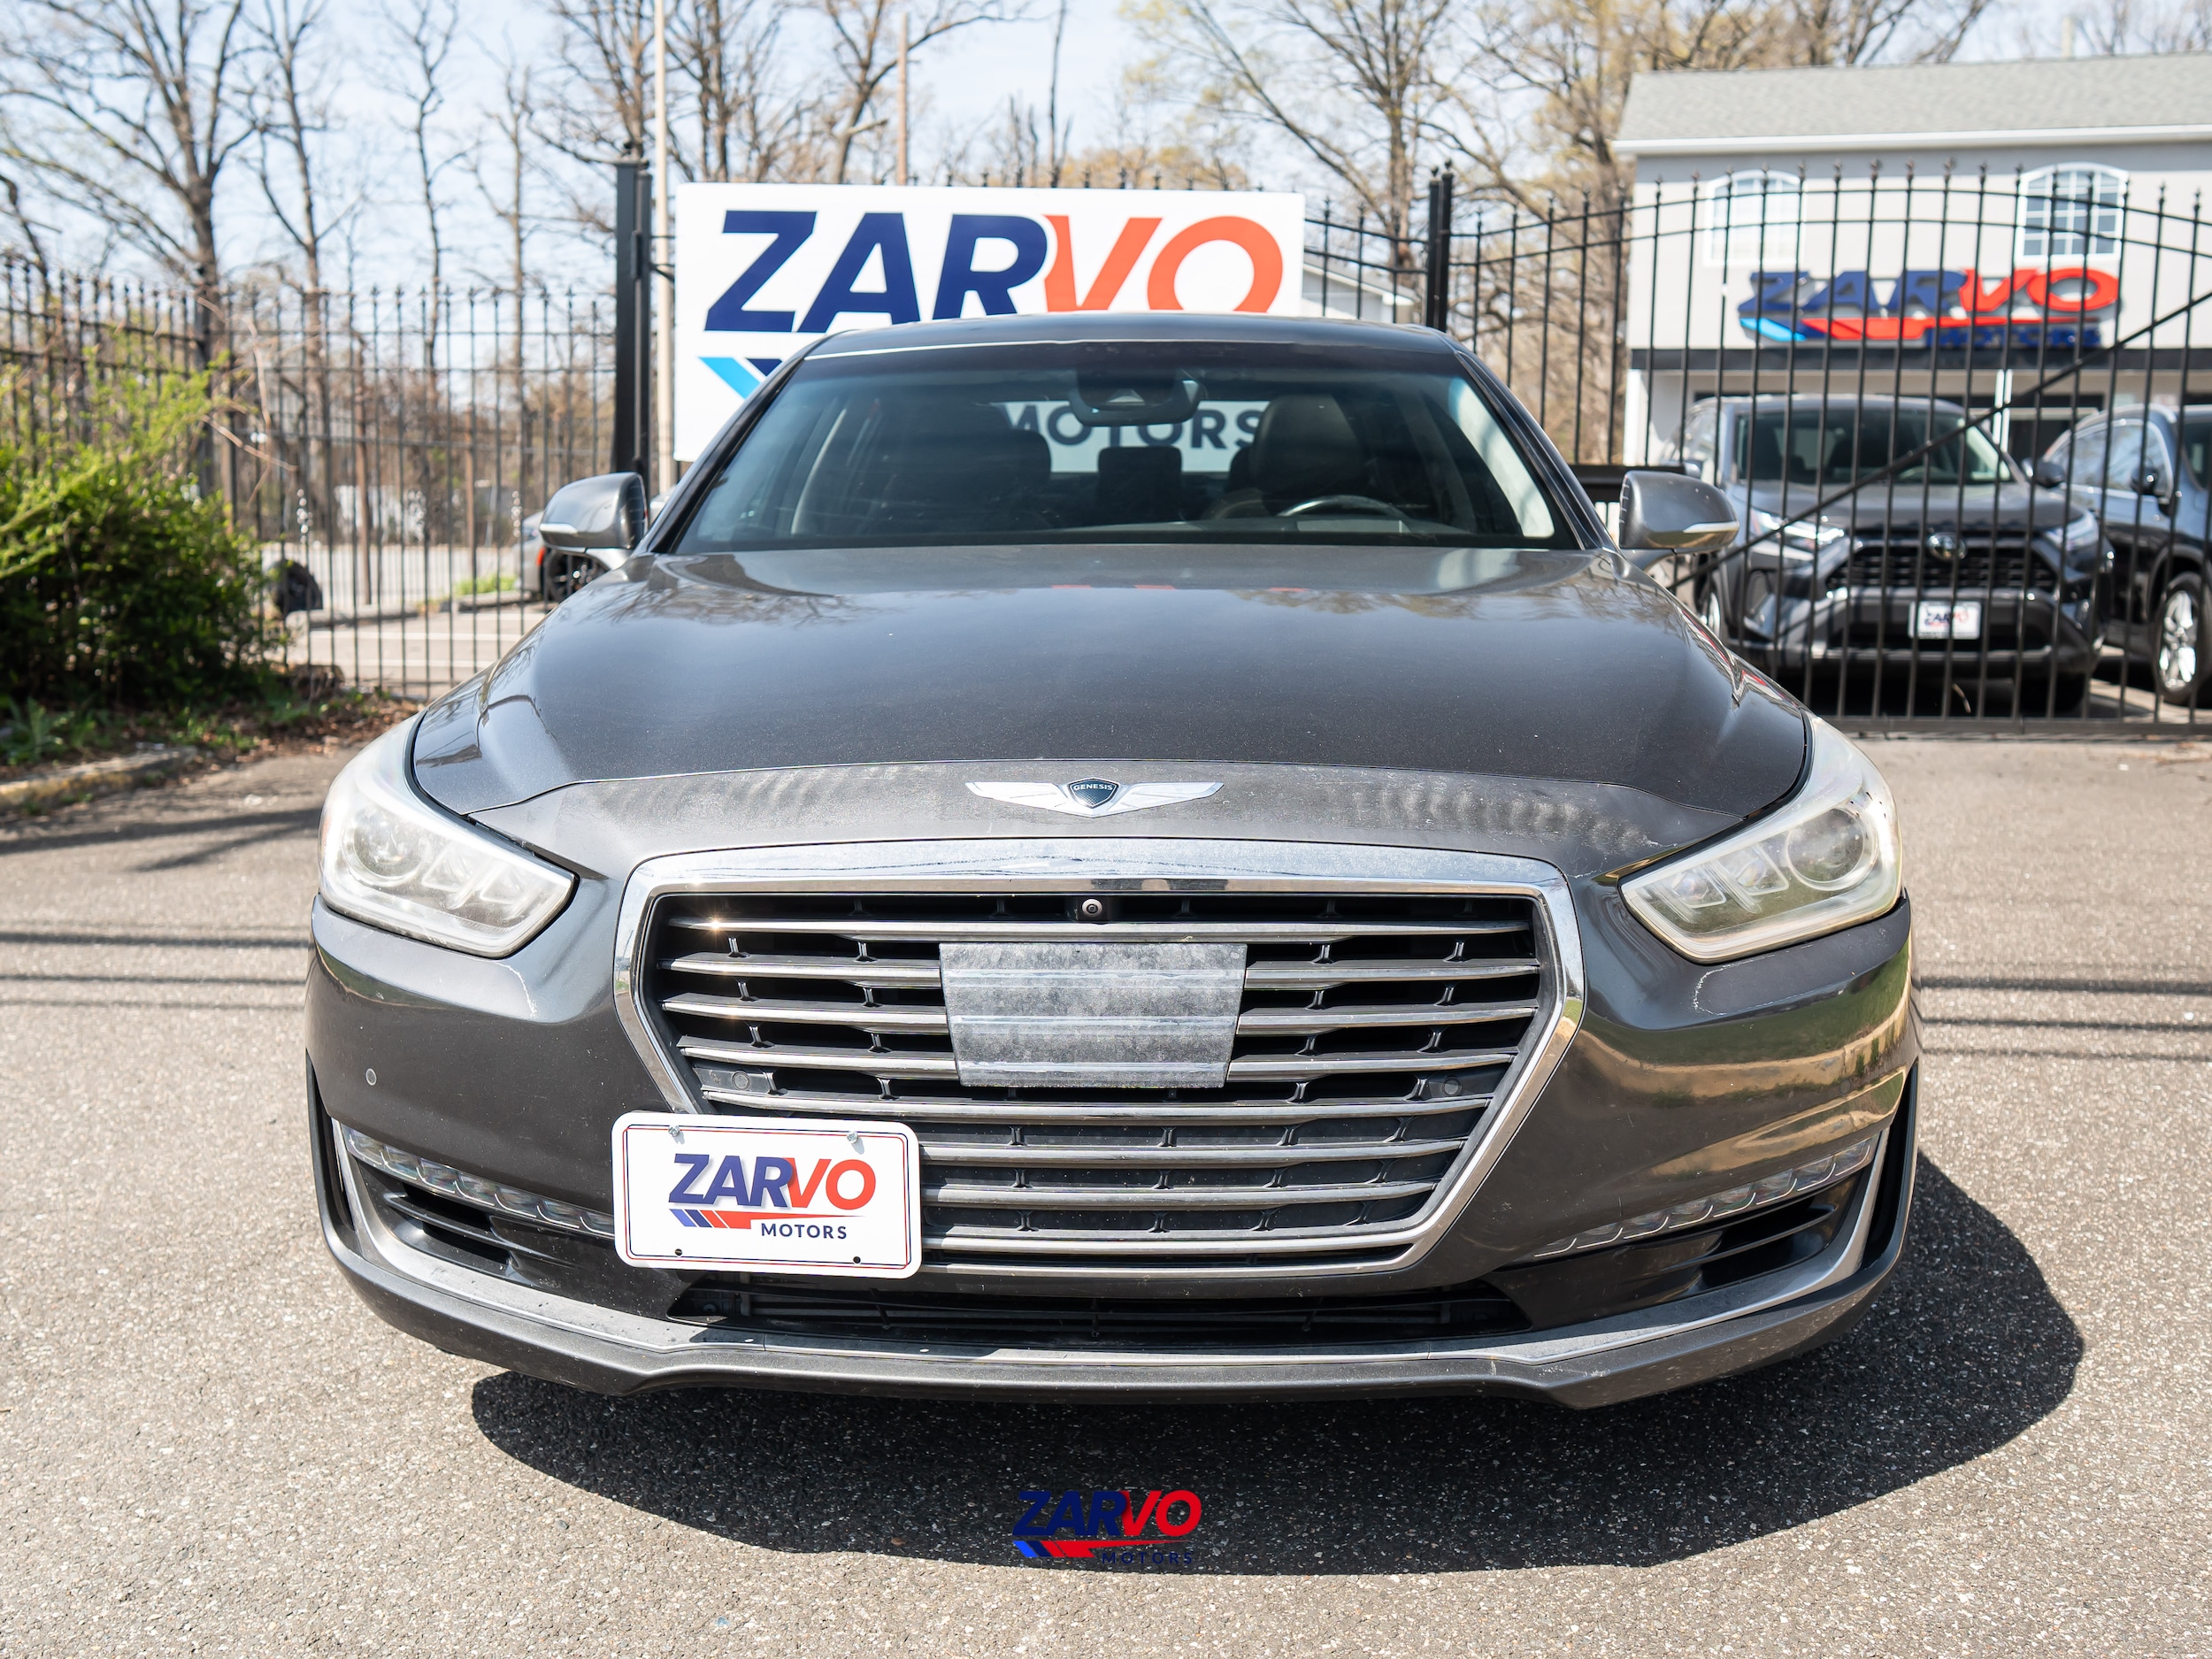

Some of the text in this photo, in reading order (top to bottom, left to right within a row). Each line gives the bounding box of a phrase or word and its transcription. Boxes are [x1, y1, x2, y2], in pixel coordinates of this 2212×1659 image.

[704, 210, 1284, 333] ZARVO
[1738, 268, 2120, 312] ZARVO
[668, 1153, 876, 1210] ZARVO
[761, 1223, 847, 1239] MOTORS
